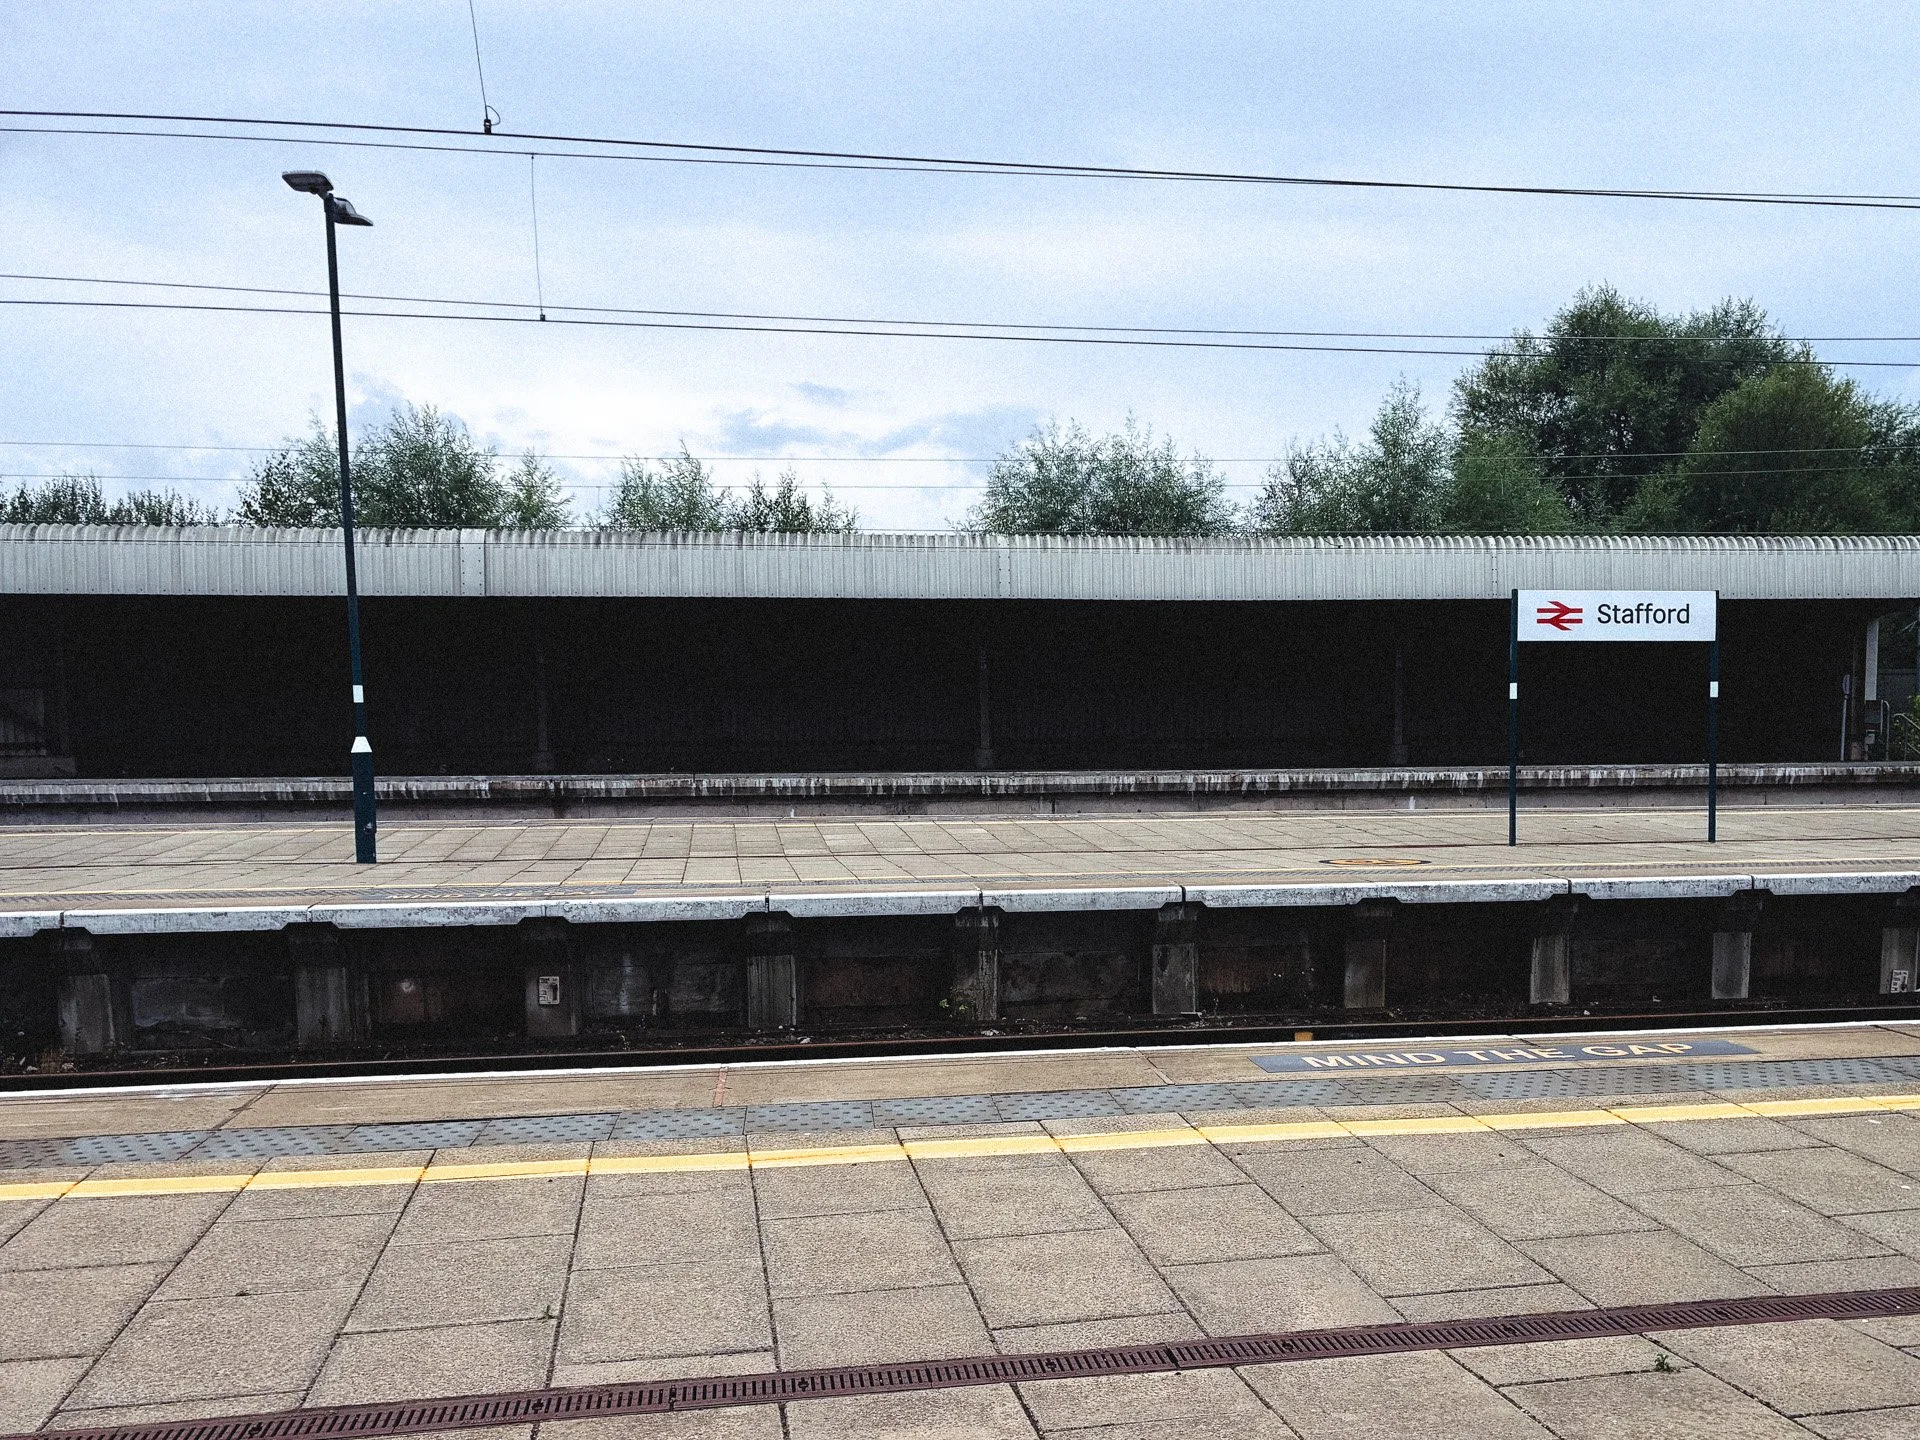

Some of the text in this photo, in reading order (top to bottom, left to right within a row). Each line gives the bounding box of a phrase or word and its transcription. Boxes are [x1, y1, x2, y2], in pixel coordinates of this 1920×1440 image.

[1597, 603, 1690, 624] Stafford
[1301, 1043, 1693, 1068] MIND THE GAP
